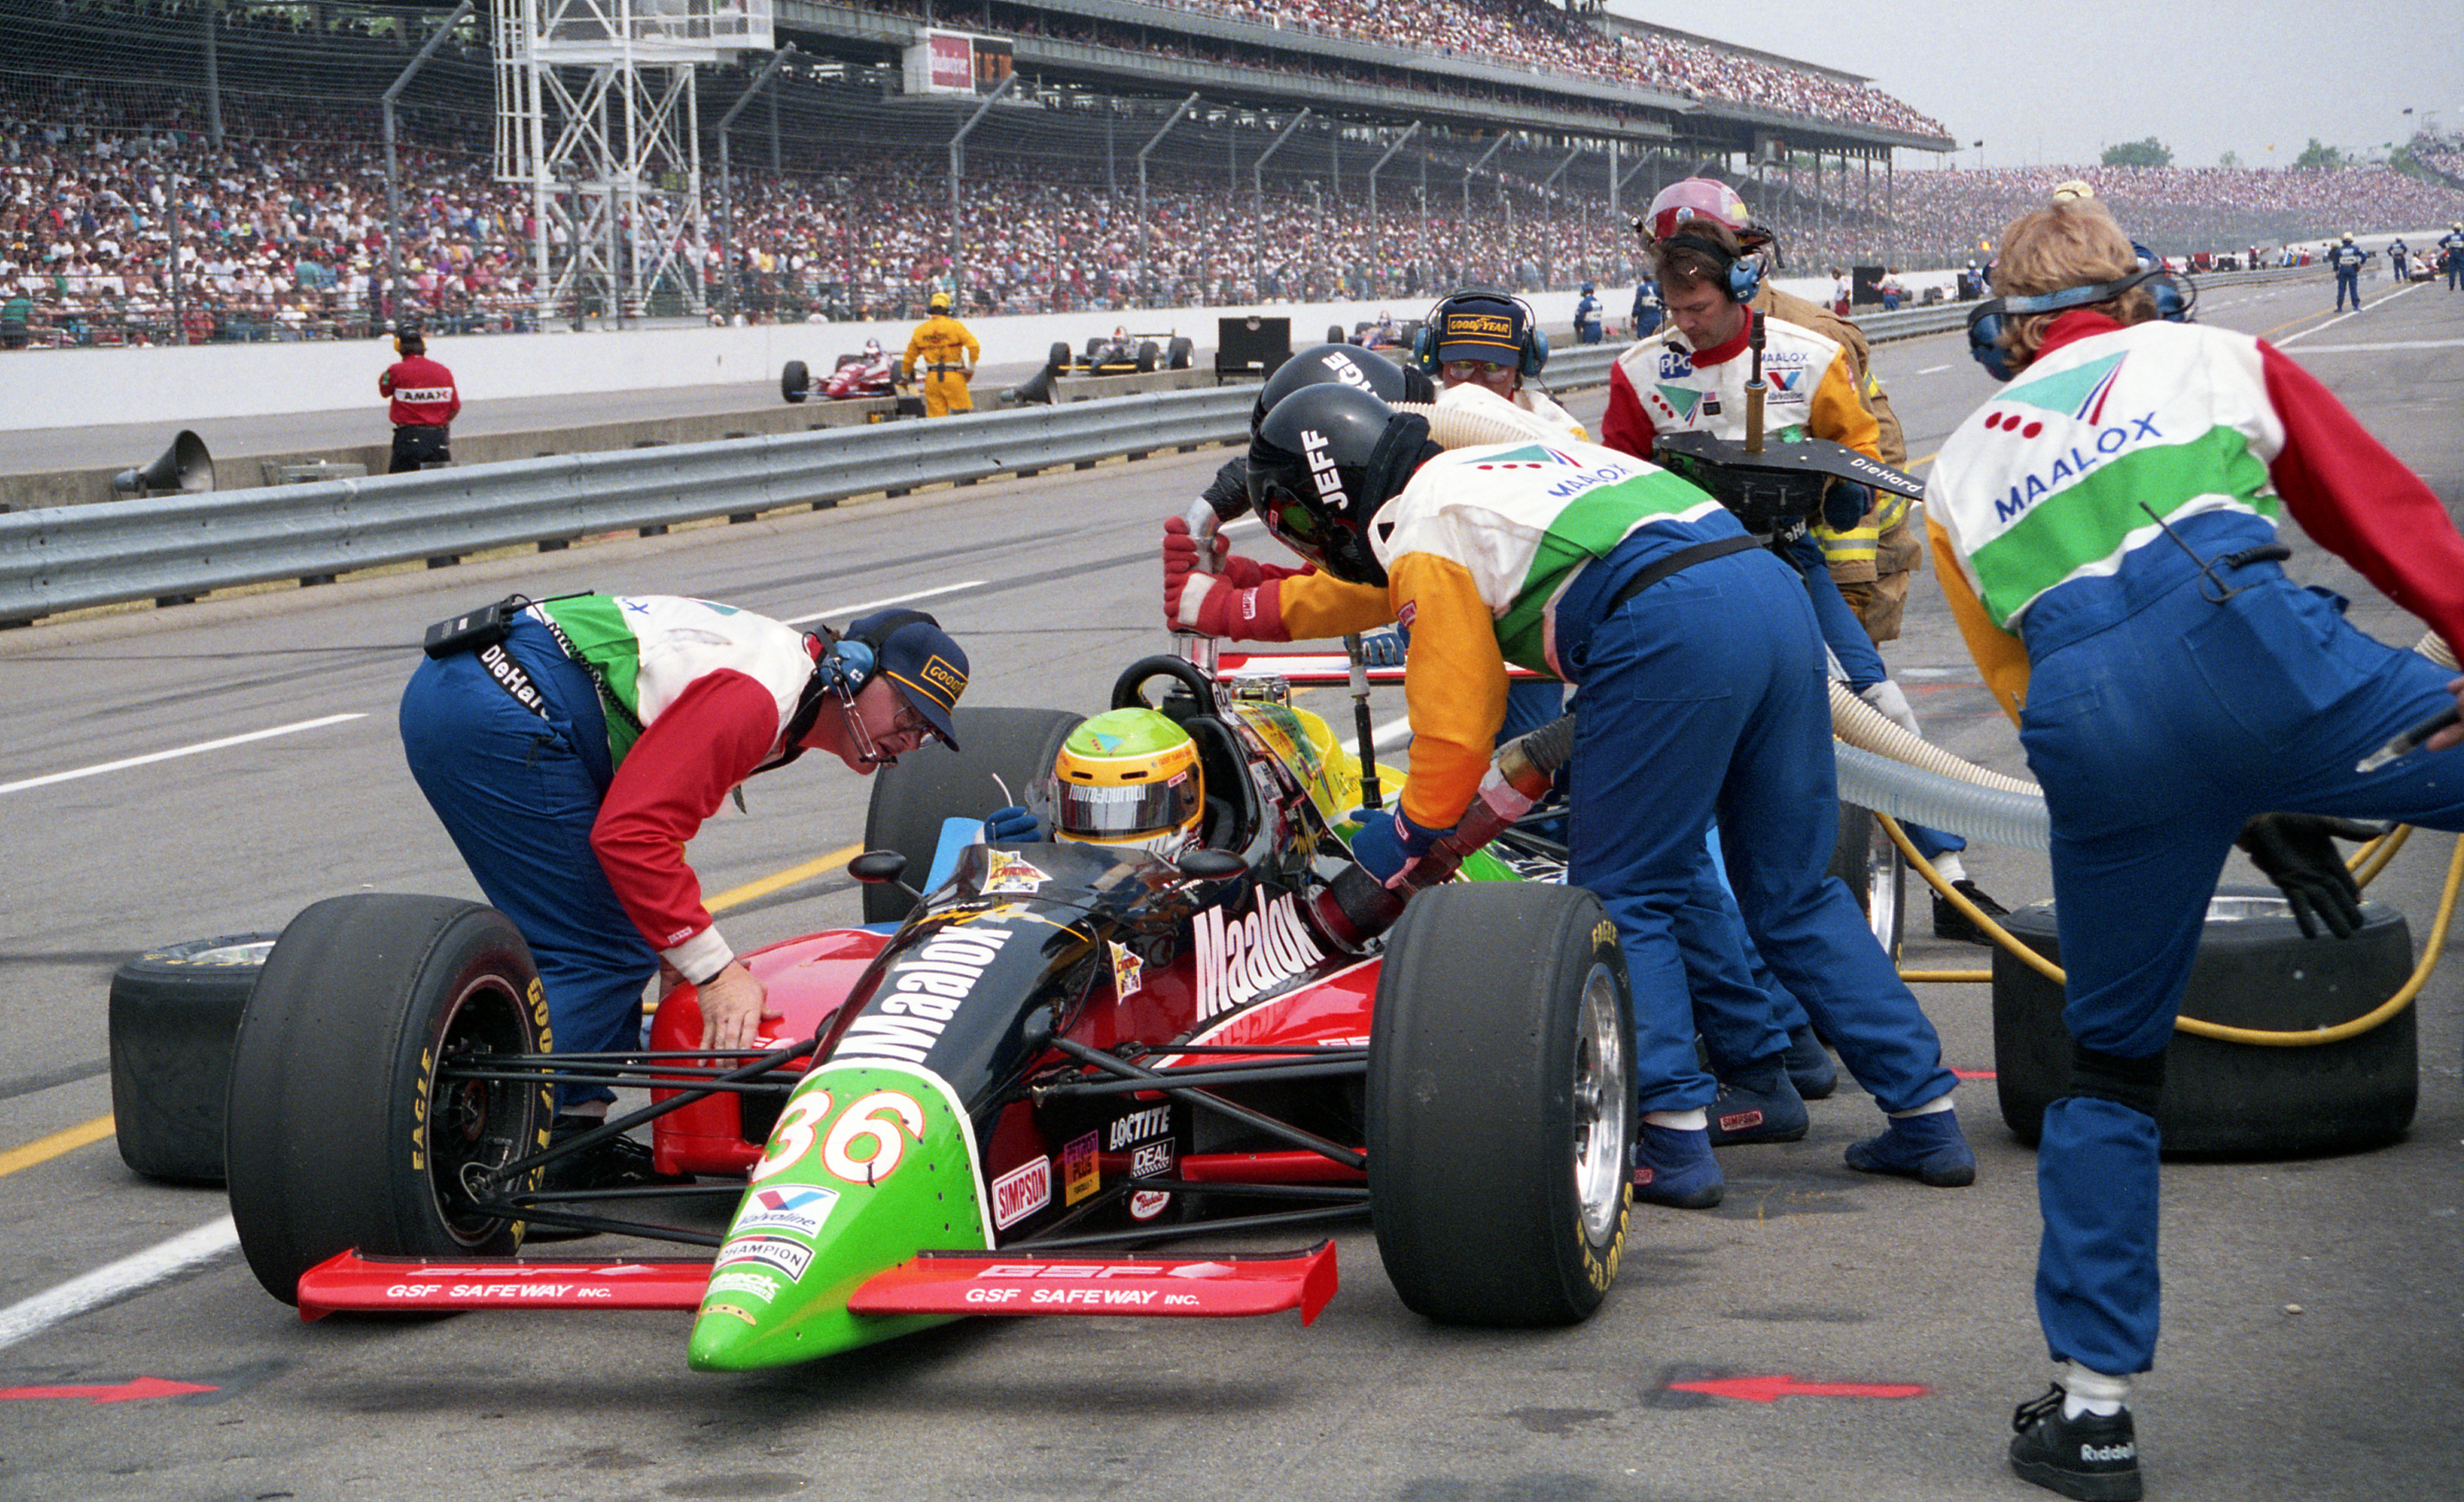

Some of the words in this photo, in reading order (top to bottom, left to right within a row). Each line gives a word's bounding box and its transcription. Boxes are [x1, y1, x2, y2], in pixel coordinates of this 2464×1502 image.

[1660, 352, 1692, 375] PPG
[404, 391, 448, 401] AMAX
[1301, 429, 1349, 511] JEFF
[1547, 463, 1633, 498] MAALOX
[1850, 457, 1924, 493] DieHard
[1994, 411, 2163, 523] MAALOX
[1192, 883, 1326, 1023] Maalox
[1592, 919, 1617, 955] EAGLE
[833, 925, 1013, 1064] Maalox
[412, 1047, 432, 1171] EAGLE
[1722, 1109, 1761, 1128] SIMPSON
[749, 1090, 925, 1185] 36
[1110, 1104, 1171, 1152] LOCTITE
[1133, 1143, 1170, 1170] IDEAL
[998, 1166, 1046, 1220] SIMPSON
[736, 1212, 816, 1227] Valvoline
[386, 1285, 442, 1297] GSF
[449, 1285, 574, 1297] SAFEWAY
[577, 1287, 612, 1297] INC.
[966, 1289, 1022, 1303] GSF
[1030, 1289, 1158, 1304] SAFEWAY
[1163, 1294, 1200, 1305] INC.
